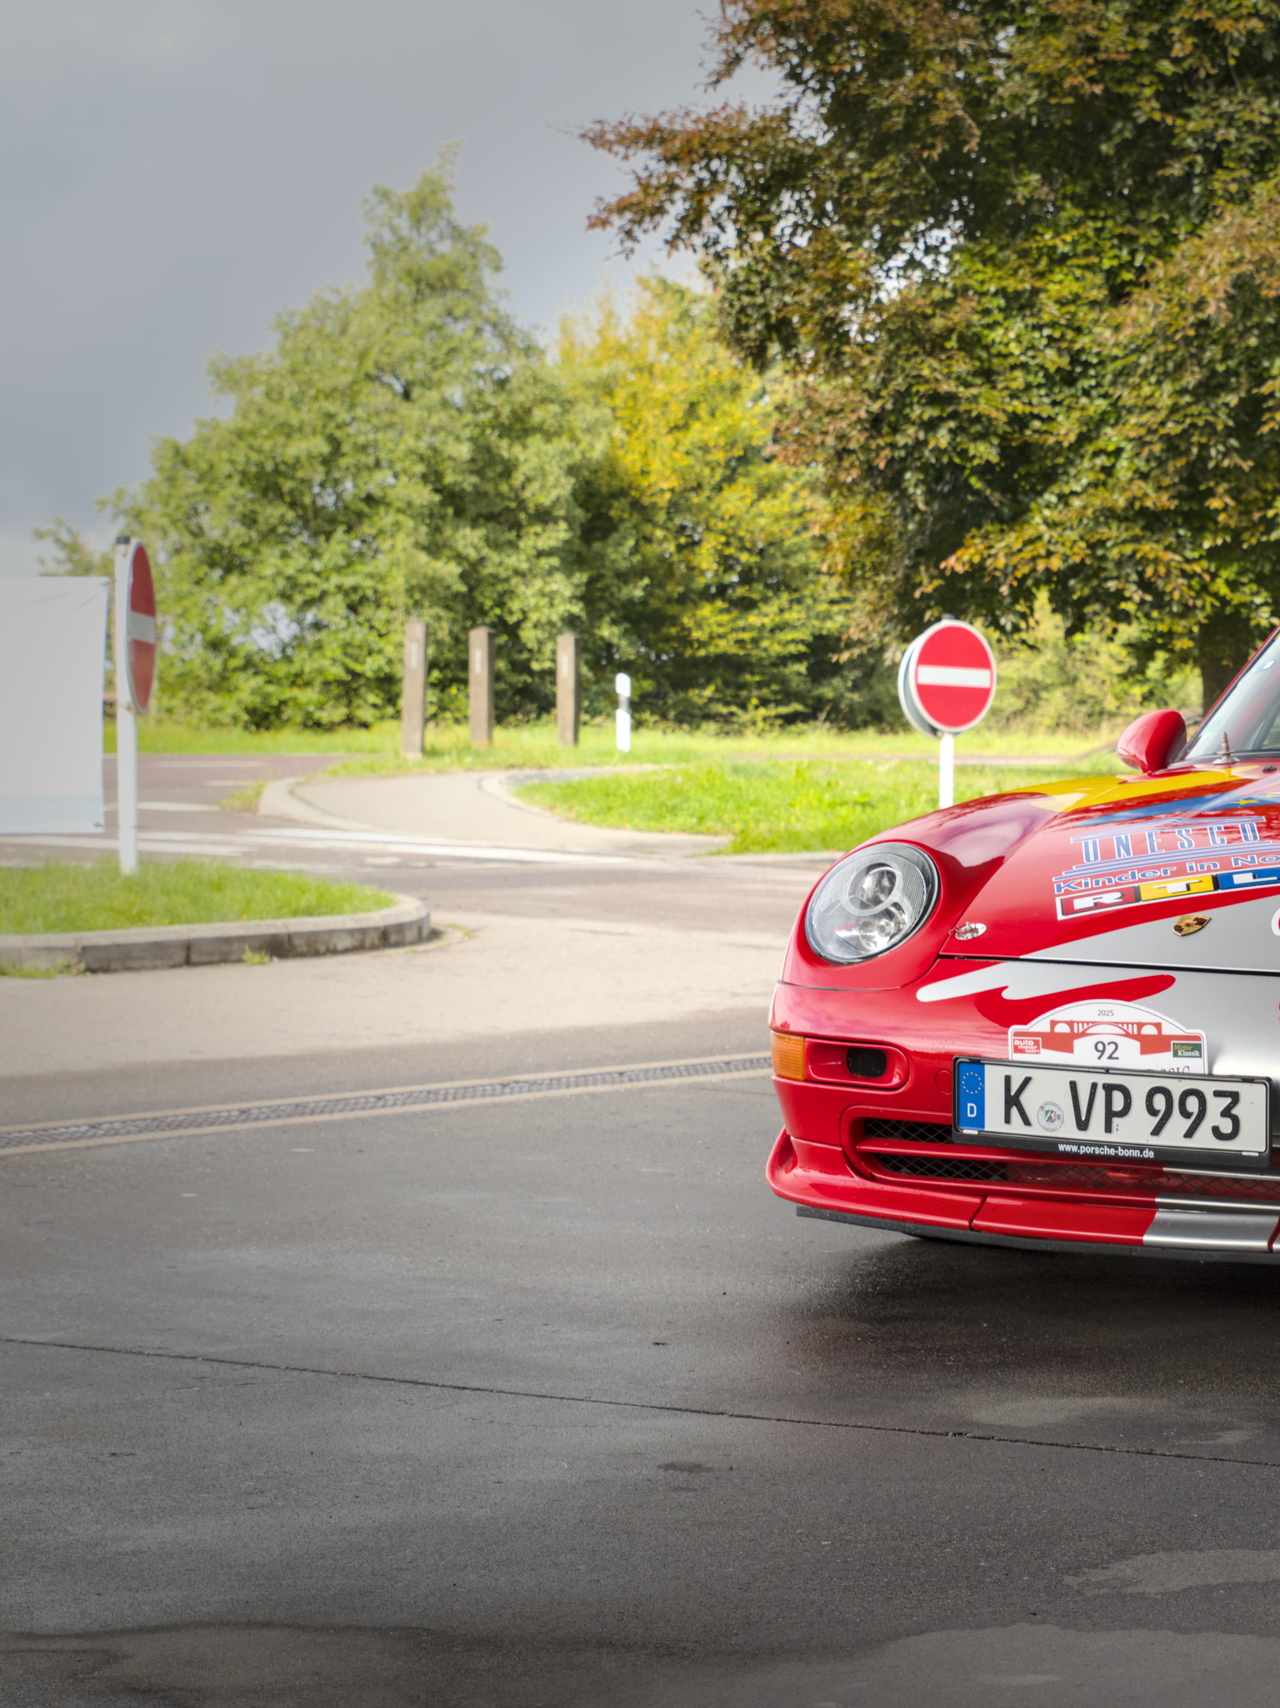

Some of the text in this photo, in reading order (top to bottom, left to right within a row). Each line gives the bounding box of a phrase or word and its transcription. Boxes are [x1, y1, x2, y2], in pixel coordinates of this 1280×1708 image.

[1081, 822, 1260, 864] UNESCO
[1053, 866, 1177, 894] Kinder
[1186, 861, 1220, 873] in
[1071, 872, 1280, 911] RTL
[1097, 1009, 1115, 1017] 2025
[1094, 1041, 1119, 1060] 92
[1177, 1049, 1200, 1057] Klassik
[966, 1102, 977, 1118] D
[1003, 1074, 1033, 1127] K
[1068, 1079, 1132, 1135] VP
[1144, 1085, 1241, 1142] 993
[1058, 1141, 1154, 1159] www.porsche-bonn.de
